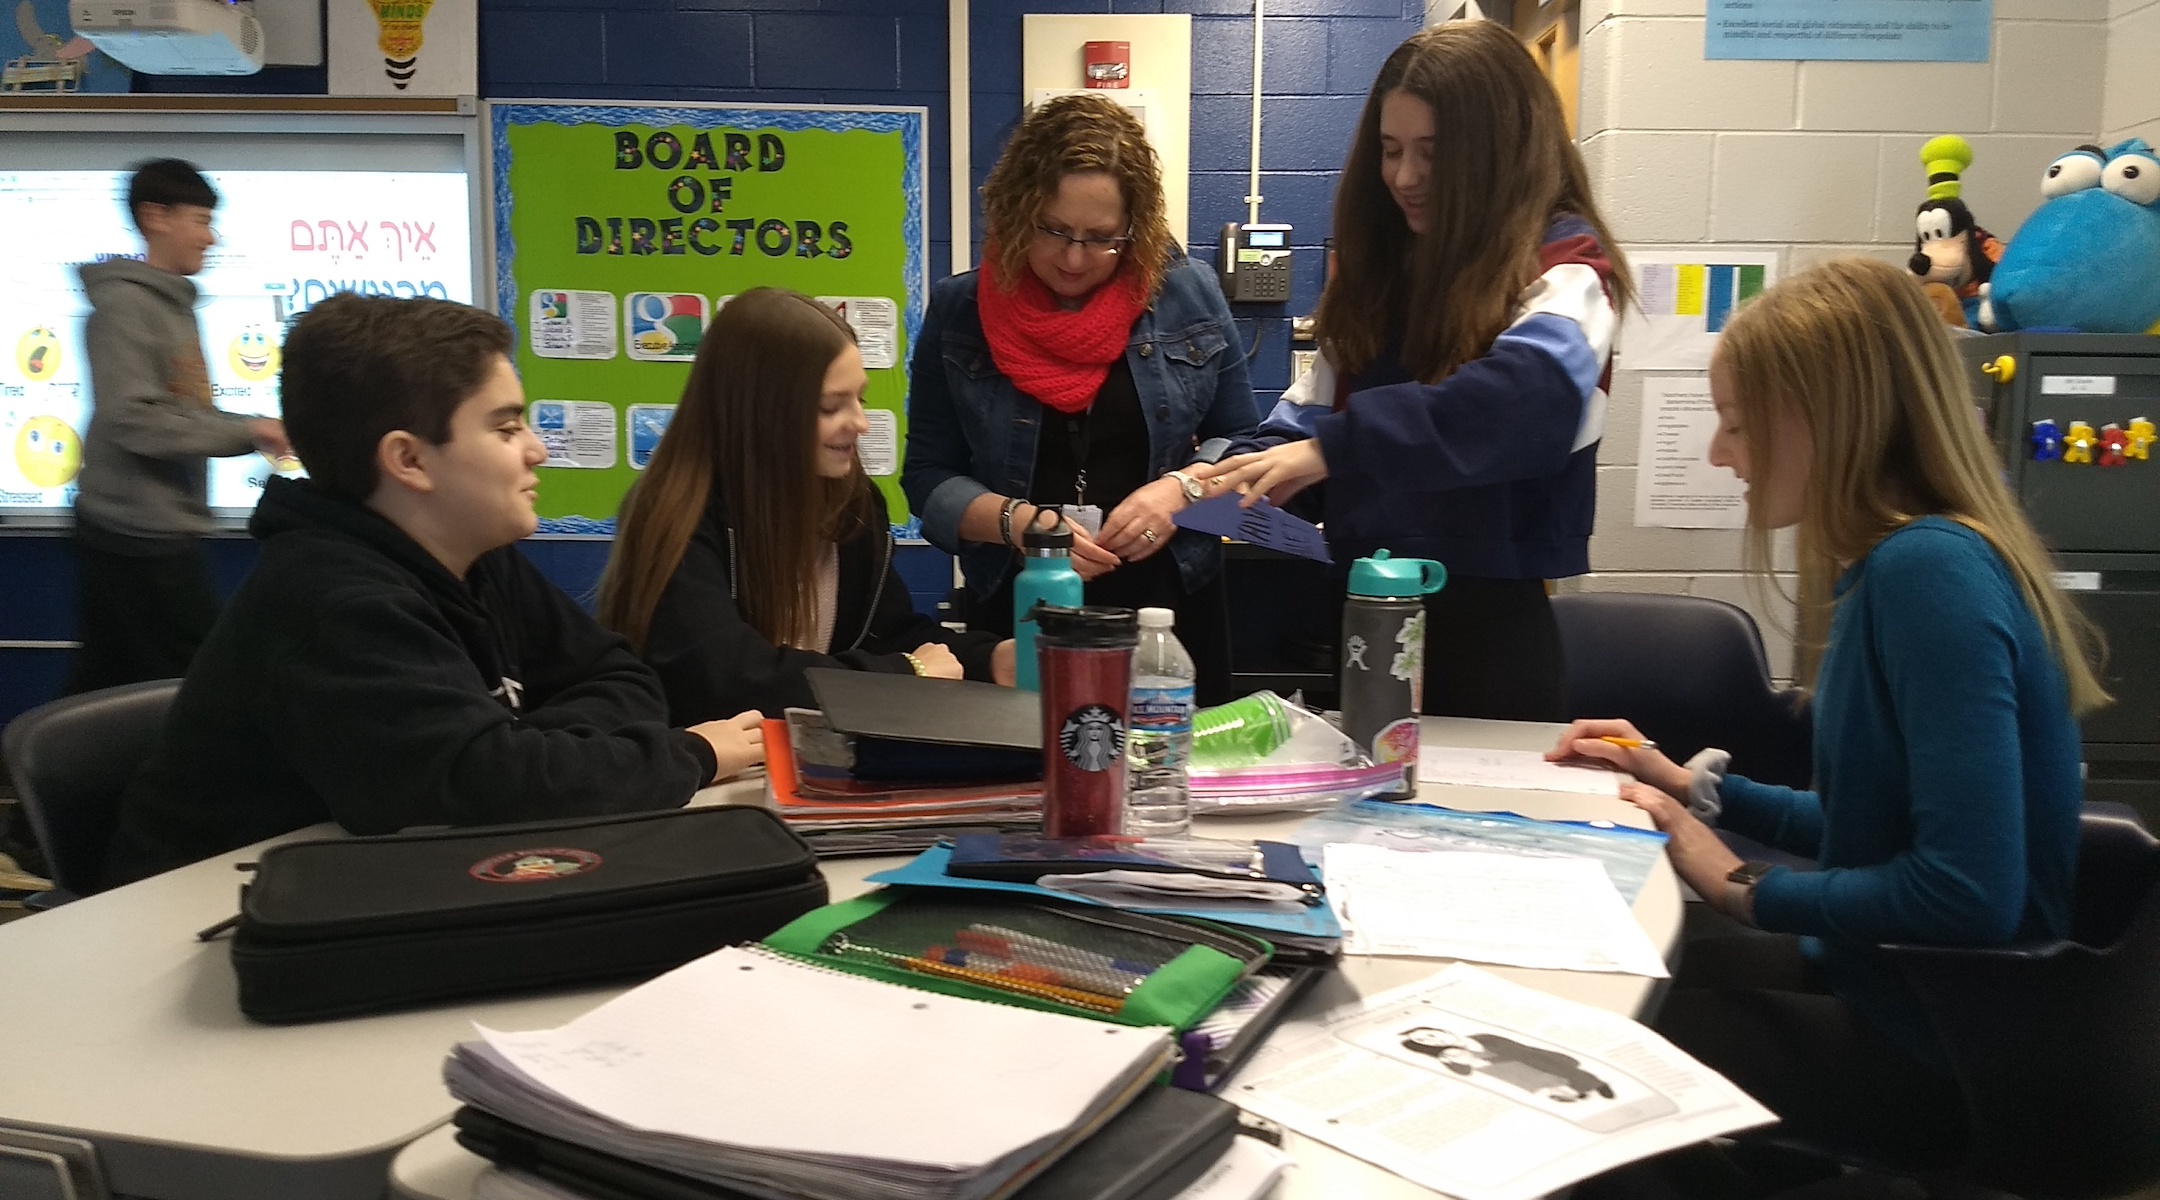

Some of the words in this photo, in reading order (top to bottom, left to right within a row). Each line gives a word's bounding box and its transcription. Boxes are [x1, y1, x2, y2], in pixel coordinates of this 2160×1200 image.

[613, 131, 786, 173] BOARD
[668, 175, 733, 214] OF
[575, 216, 853, 260] DIRECTORS
[247, 477, 266, 488] Sa
